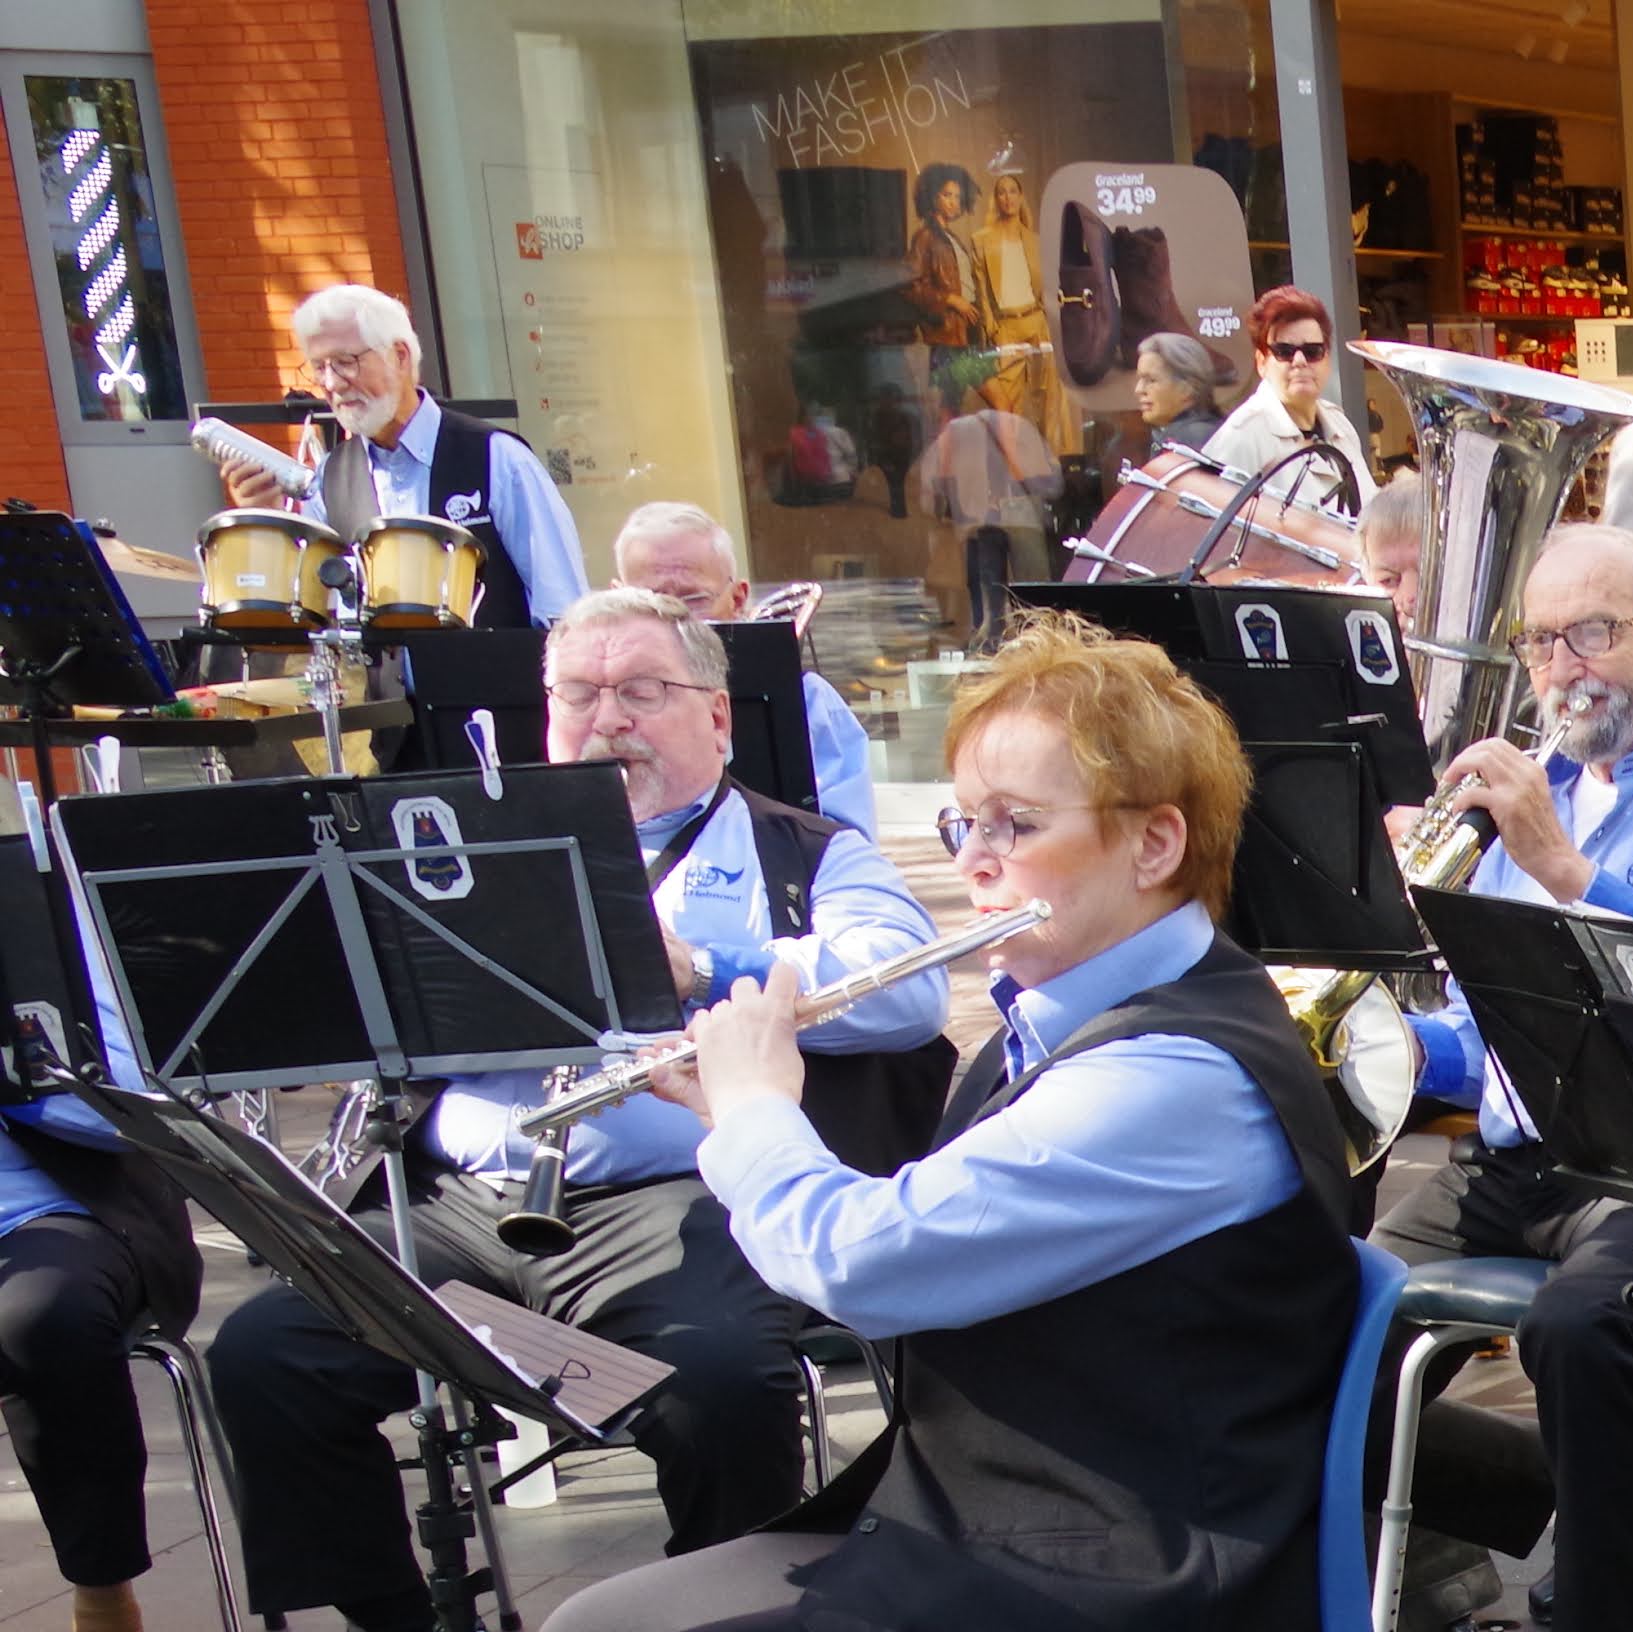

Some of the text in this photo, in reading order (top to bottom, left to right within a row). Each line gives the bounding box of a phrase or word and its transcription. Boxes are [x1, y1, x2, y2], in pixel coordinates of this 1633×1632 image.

[751, 61, 867, 143] MAKE
[1095, 172, 1144, 187] Graceland
[1097, 186, 1156, 216] 34.99
[539, 232, 584, 250] SHOP
